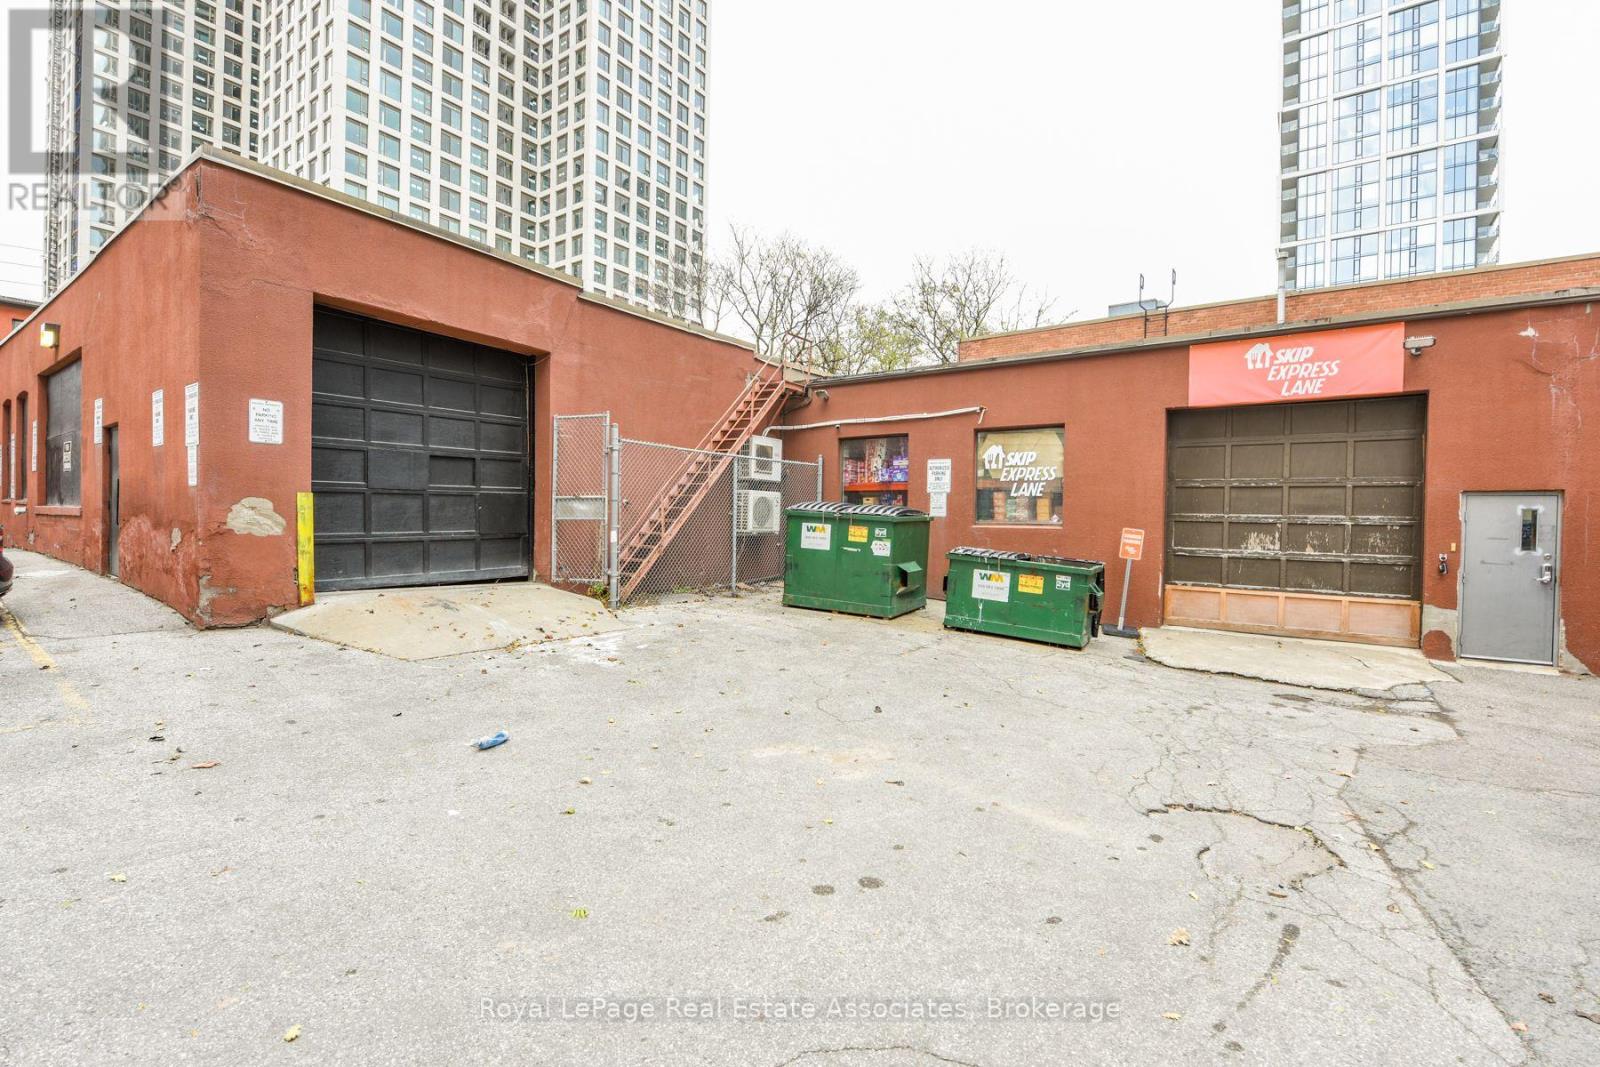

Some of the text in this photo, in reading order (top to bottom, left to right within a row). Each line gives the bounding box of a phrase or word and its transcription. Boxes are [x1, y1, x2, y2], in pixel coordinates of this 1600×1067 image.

[1273, 346, 1314, 365] SKIP
[1267, 360, 1340, 381] EXPRESS
[1281, 378, 1325, 396] LANE
[1005, 452, 1036, 466] SKIP
[1000, 466, 1057, 481] EXPRESS
[1010, 482, 1046, 497] LANE
[806, 525, 826, 533] WM
[979, 572, 1004, 583] WM
